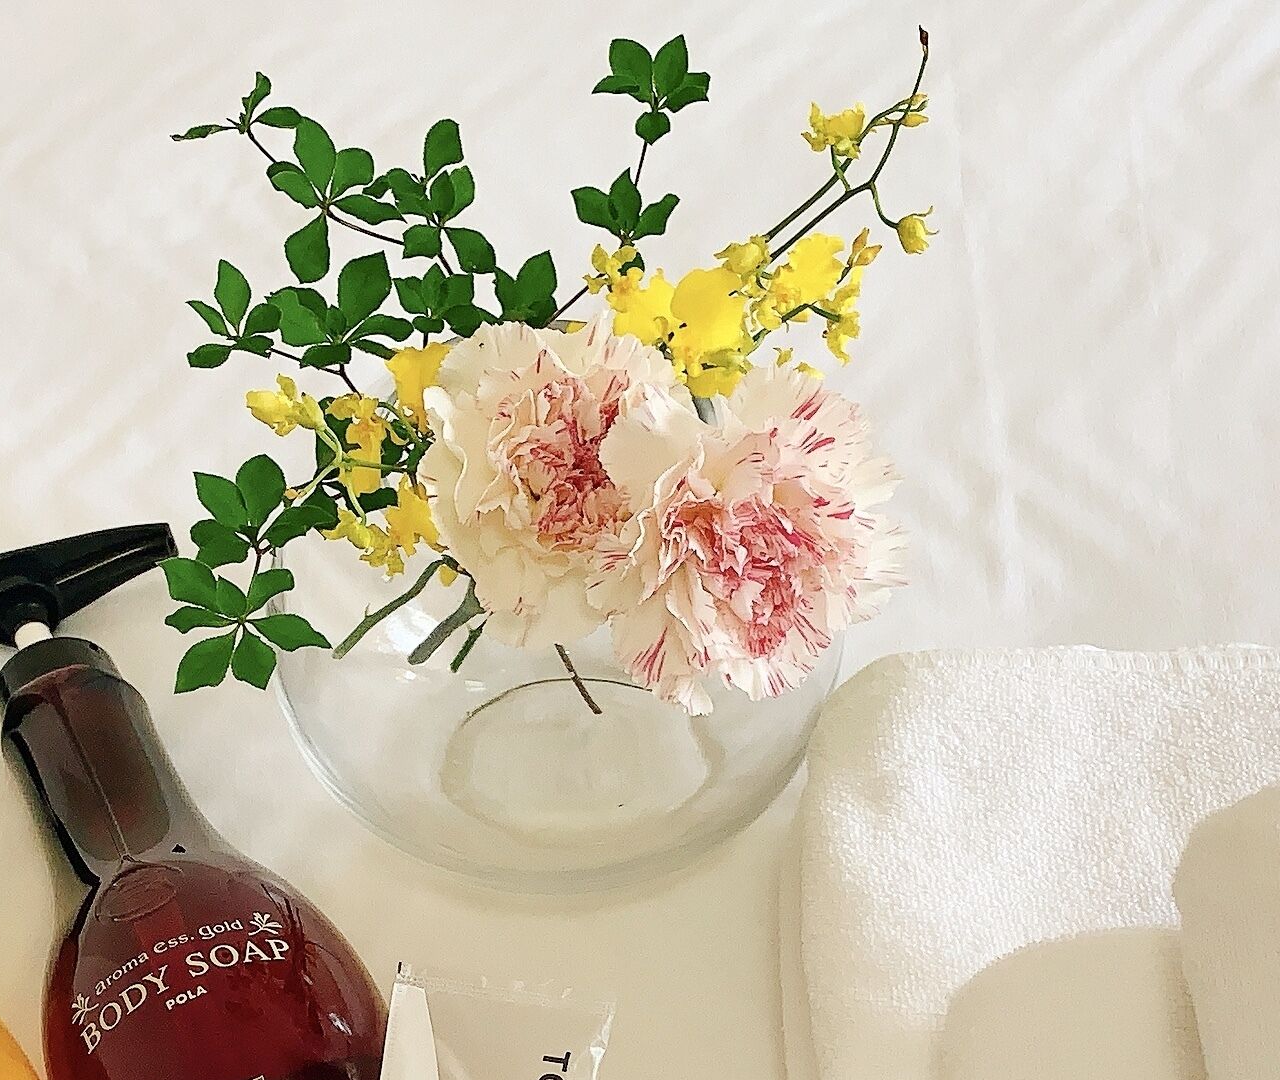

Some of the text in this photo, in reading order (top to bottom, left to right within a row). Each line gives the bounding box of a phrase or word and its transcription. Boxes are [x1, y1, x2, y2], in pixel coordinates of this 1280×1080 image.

[94, 919, 243, 995] aroma ess. gold
[80, 939, 290, 1054] BODY SOAP
[166, 985, 207, 1010] POLA
